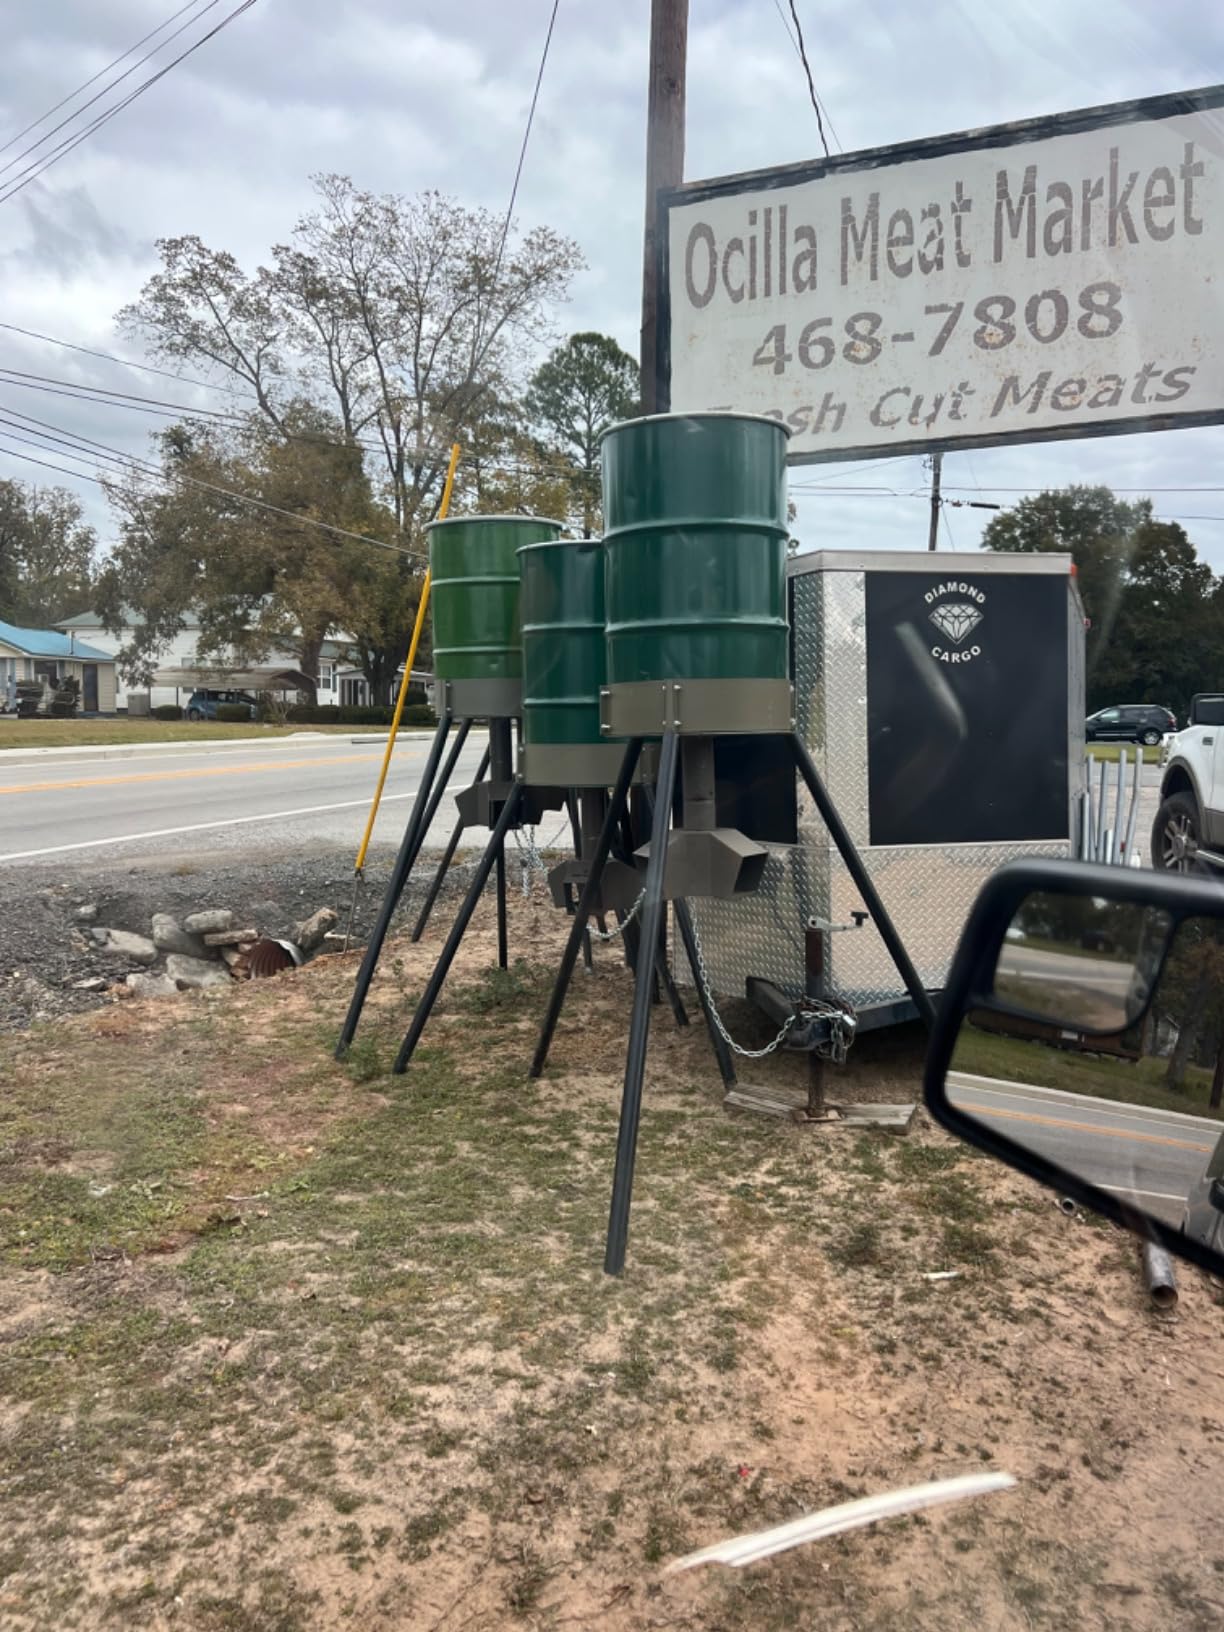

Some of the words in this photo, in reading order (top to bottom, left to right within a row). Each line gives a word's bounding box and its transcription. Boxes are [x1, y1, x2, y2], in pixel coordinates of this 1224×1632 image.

[685, 204, 818, 309] Ocilla
[840, 181, 972, 286] Meat
[993, 141, 1205, 264] Market
[752, 281, 1123, 376] 468-7808
[868, 381, 976, 431] Cut
[989, 361, 1198, 419] Meats
[924, 581, 986, 604] DIAMOND
[931, 645, 982, 663] CARGO
